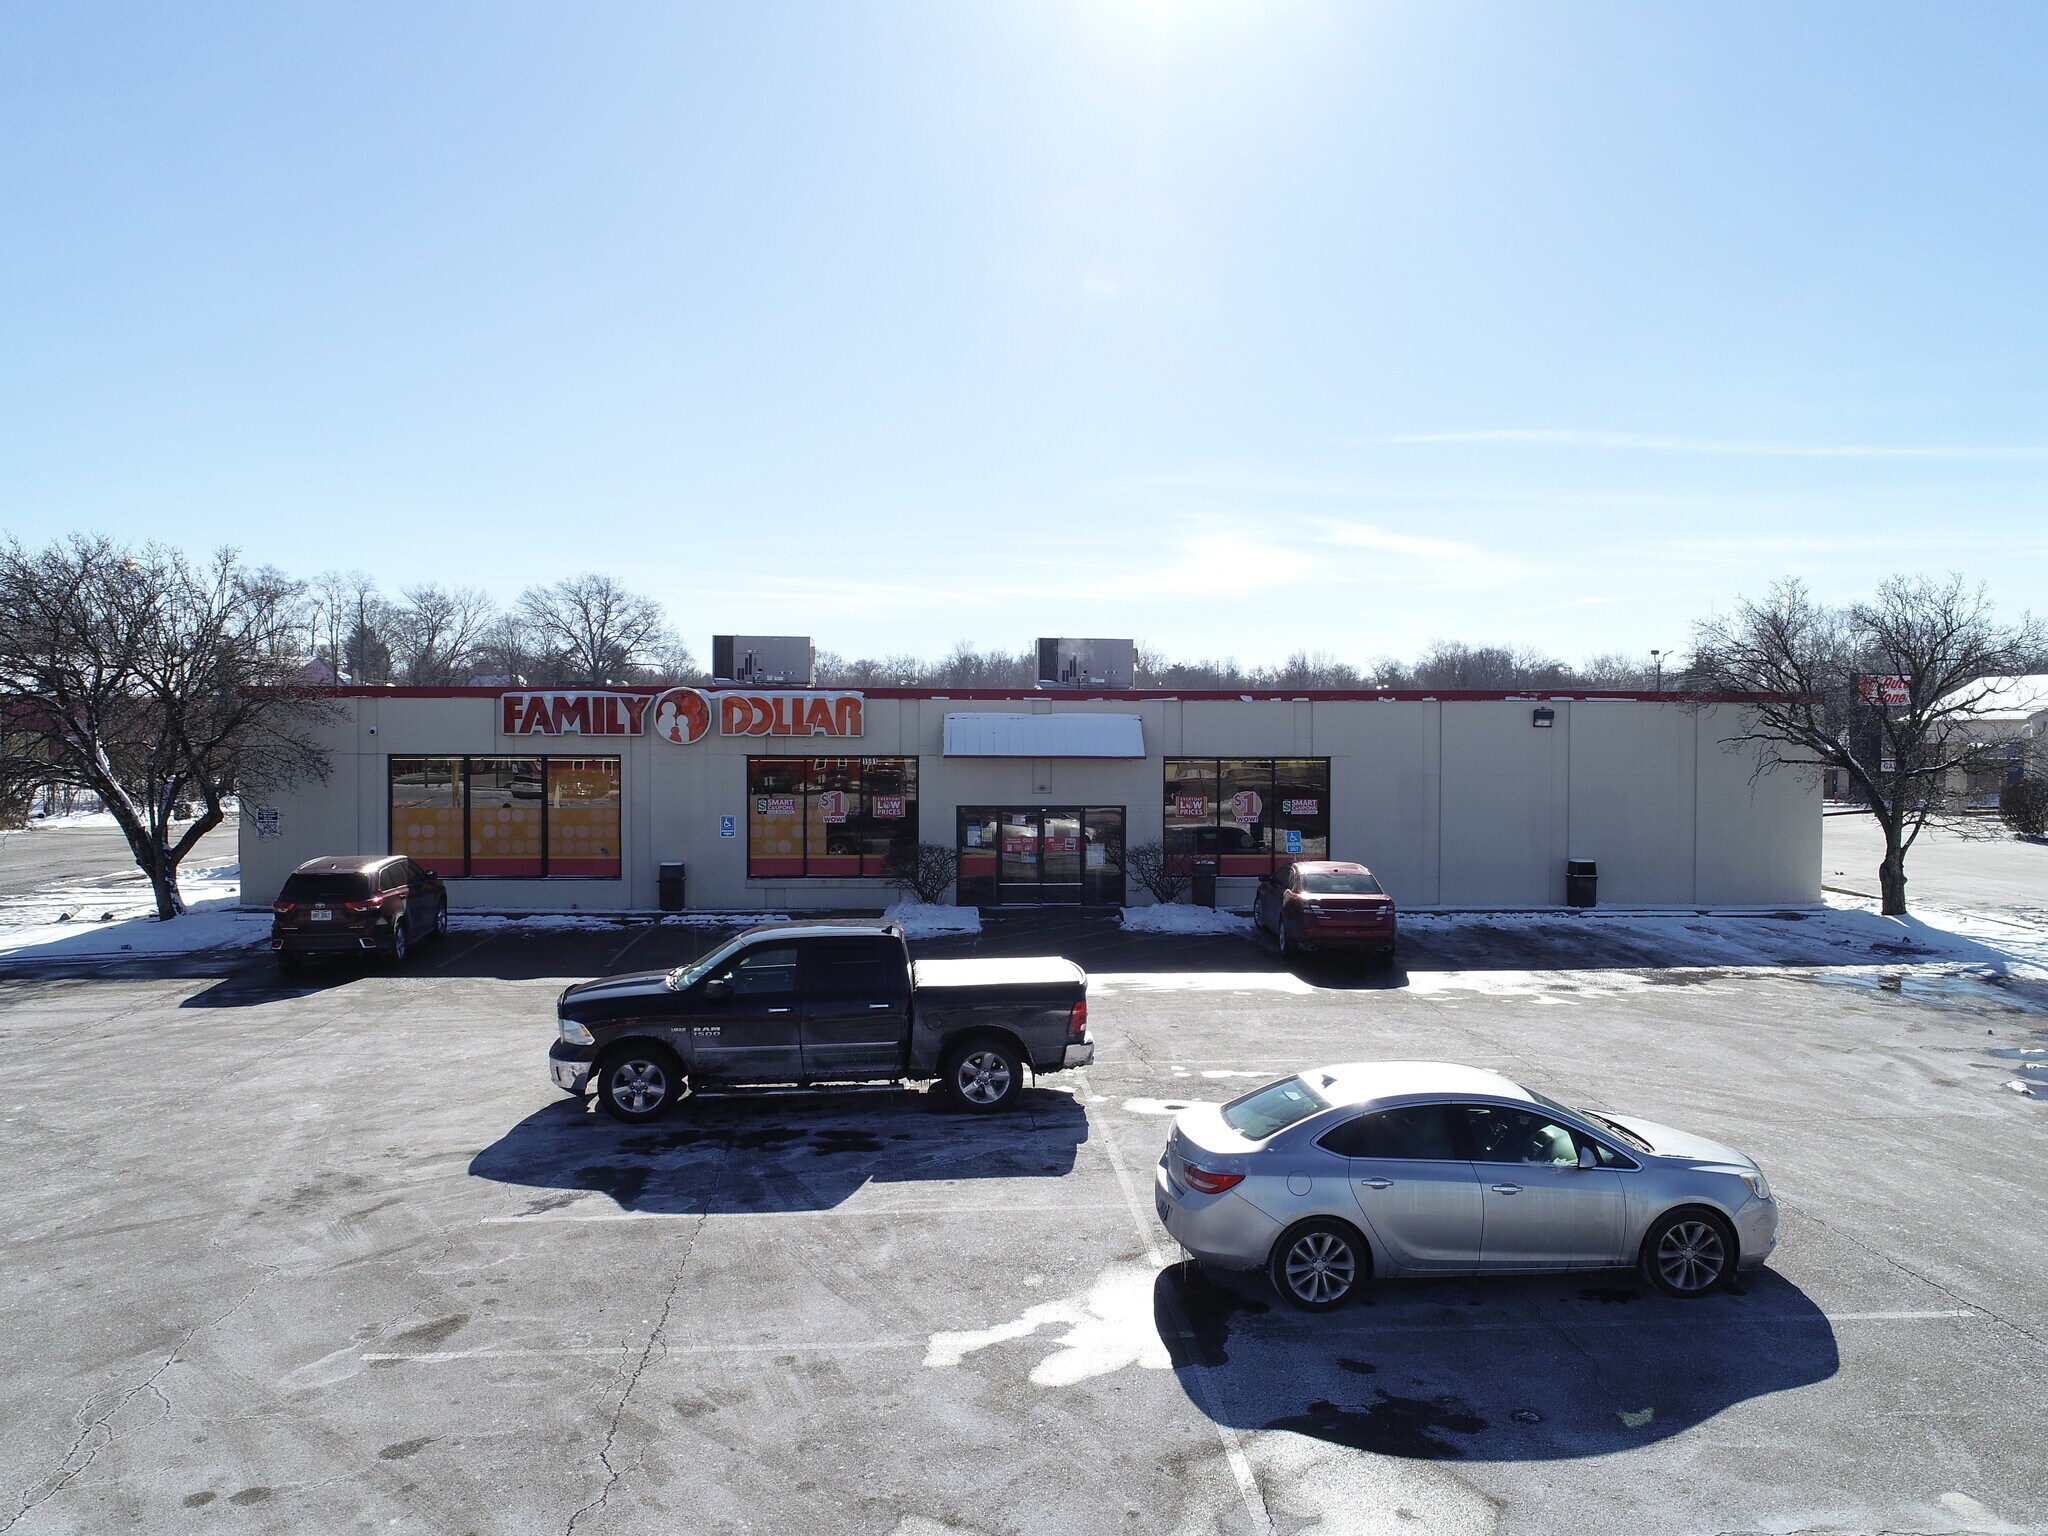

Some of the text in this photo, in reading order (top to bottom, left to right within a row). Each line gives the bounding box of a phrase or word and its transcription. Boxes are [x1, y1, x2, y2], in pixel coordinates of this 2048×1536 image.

[503, 696, 863, 736] FAMILY DOLLAR
[820, 792, 845, 817] $1
[877, 801, 901, 809] LOW
[1180, 801, 1203, 809] LOW
[1234, 792, 1258, 817] $1
